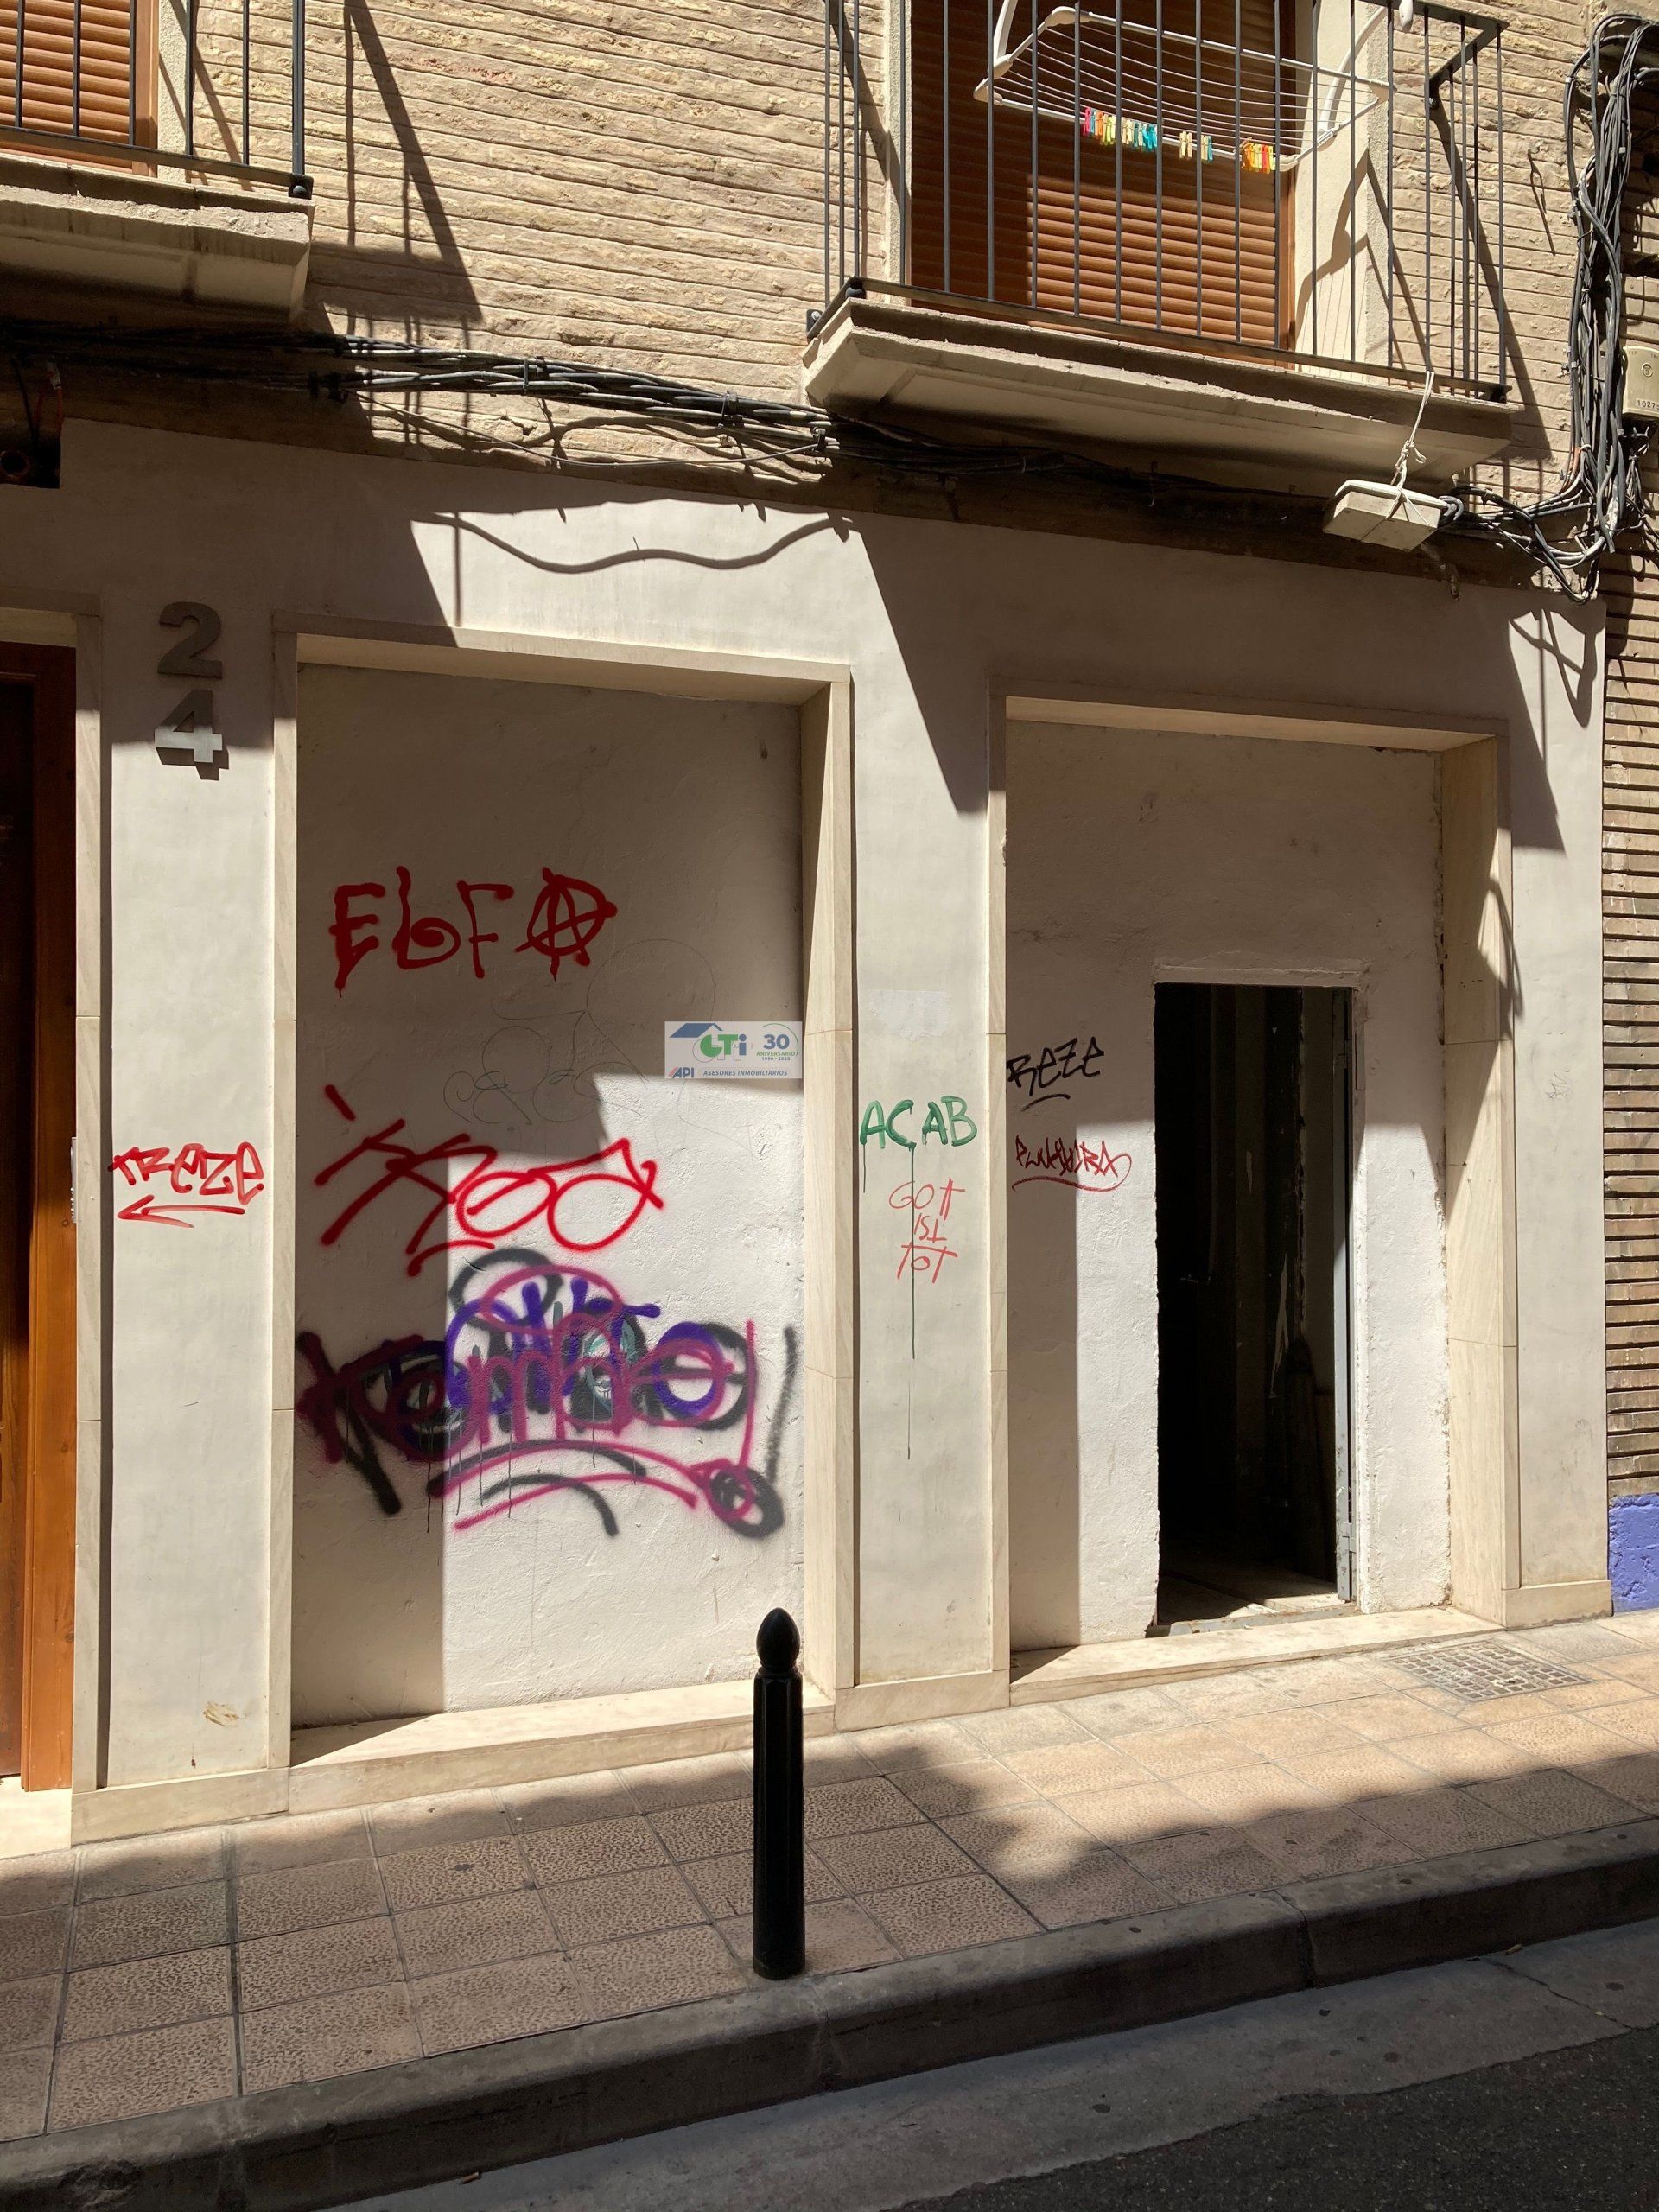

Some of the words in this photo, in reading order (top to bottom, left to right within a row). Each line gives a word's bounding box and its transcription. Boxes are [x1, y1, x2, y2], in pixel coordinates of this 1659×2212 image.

[763, 1033, 790, 1050] 30
[670, 1067, 694, 1078] API
[860, 1095, 977, 1150] ACAB
[897, 1241, 958, 1283] TOT
